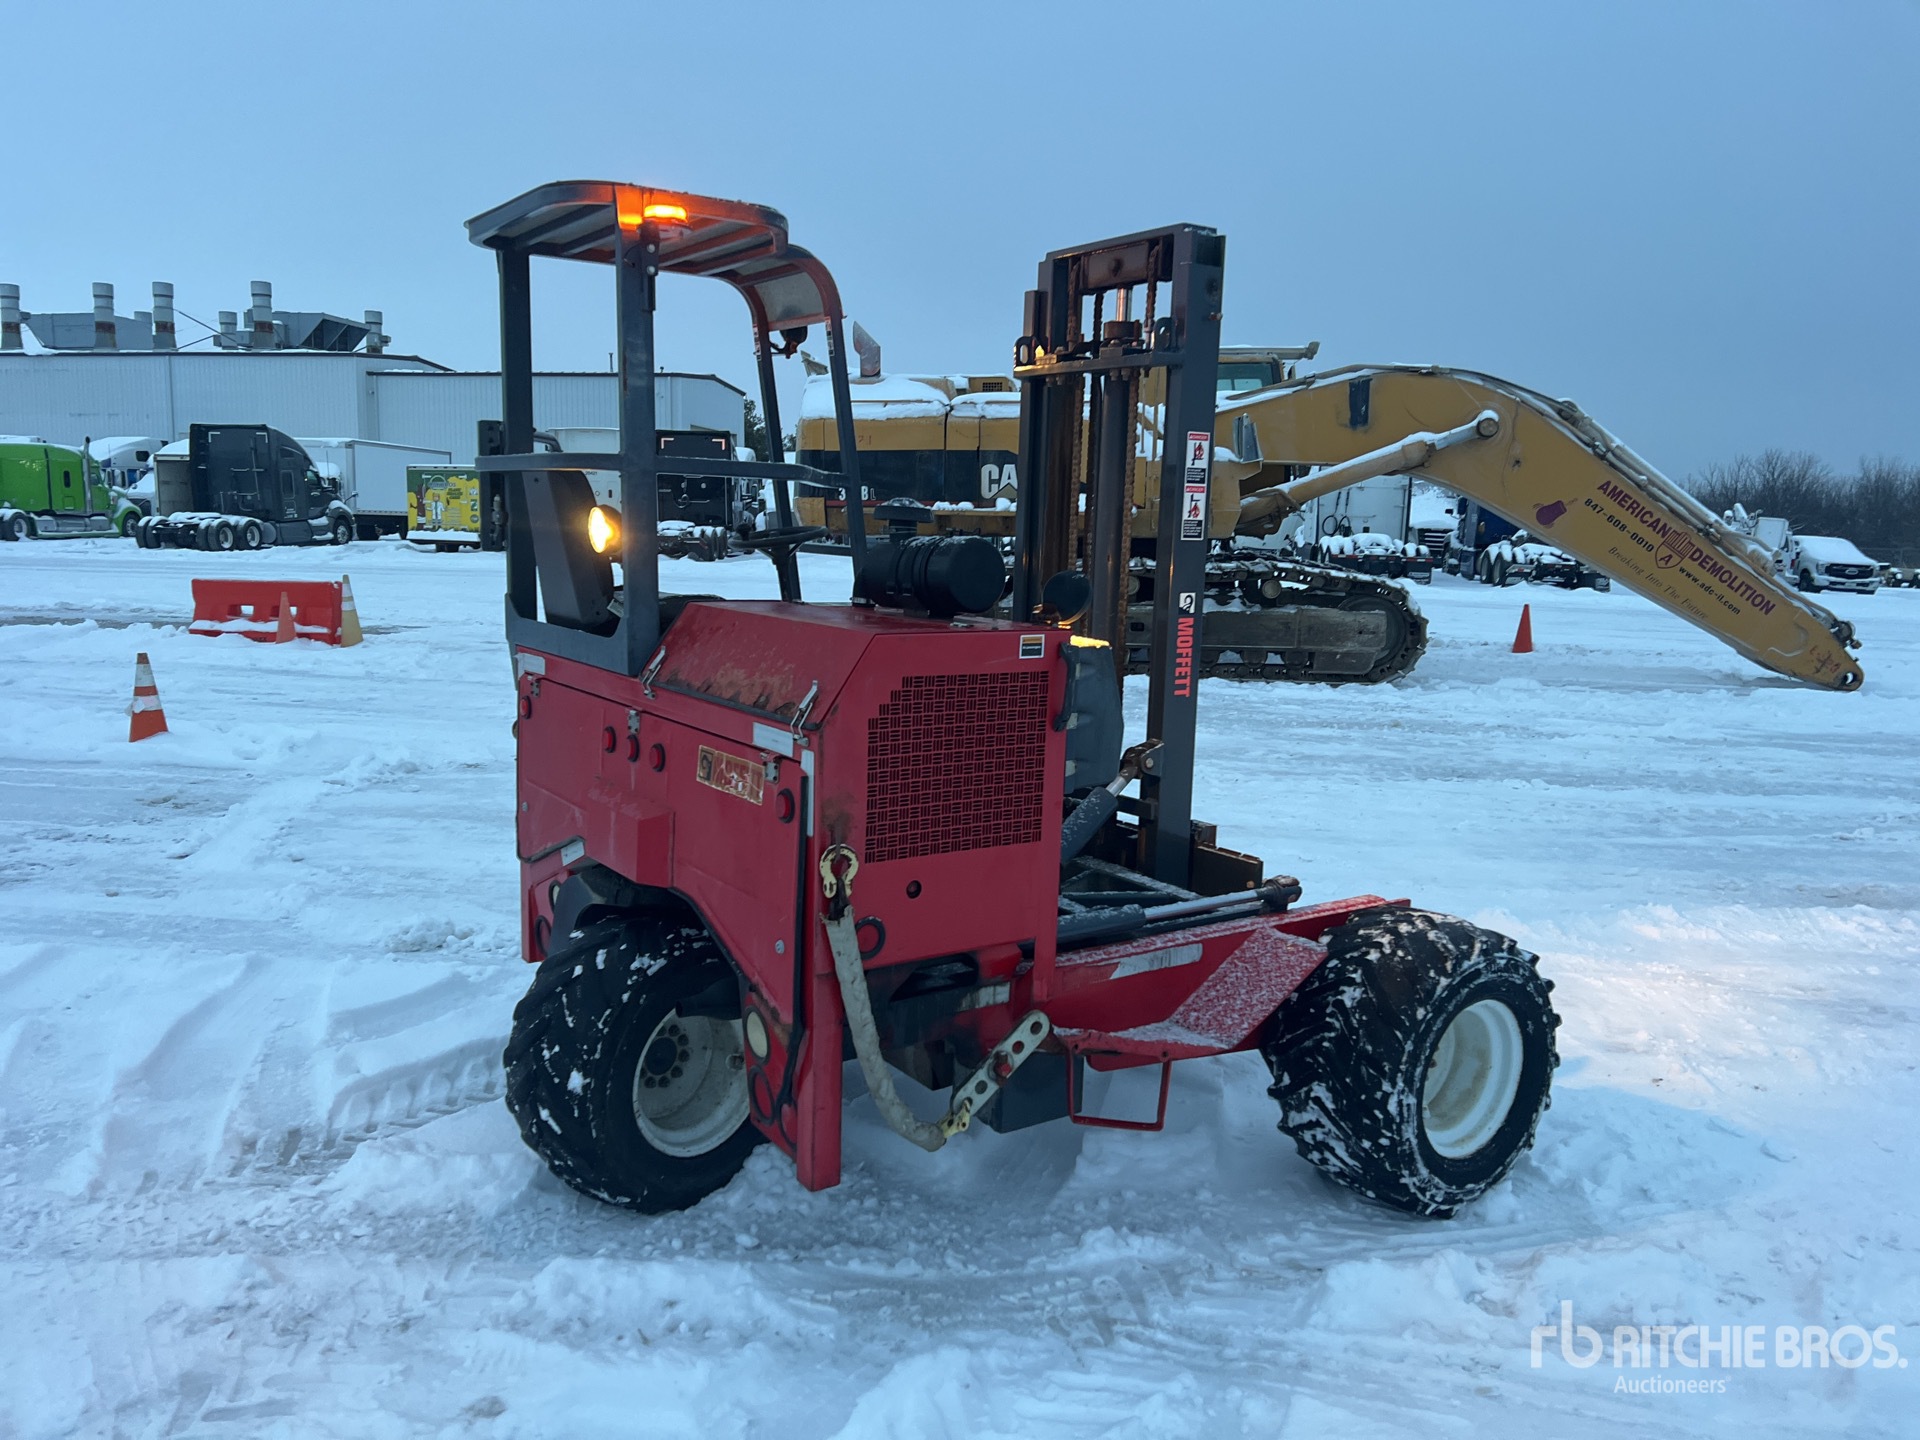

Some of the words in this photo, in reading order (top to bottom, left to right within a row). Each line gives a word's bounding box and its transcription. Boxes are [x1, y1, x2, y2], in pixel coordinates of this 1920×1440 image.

[981, 463, 1019, 499] CA
[1584, 498, 1655, 552] 847-608-0010
[1597, 480, 1672, 538] AMERICAN
[1688, 547, 1776, 615] DEMOLITION
[1608, 546, 1645, 575] Breaking
[1645, 573, 1663, 588] Into
[1663, 585, 1680, 599] The
[1659, 553, 1673, 566] A
[1679, 566, 1741, 615] www.adc-il.com
[1174, 617, 1194, 698] MOFFETT
